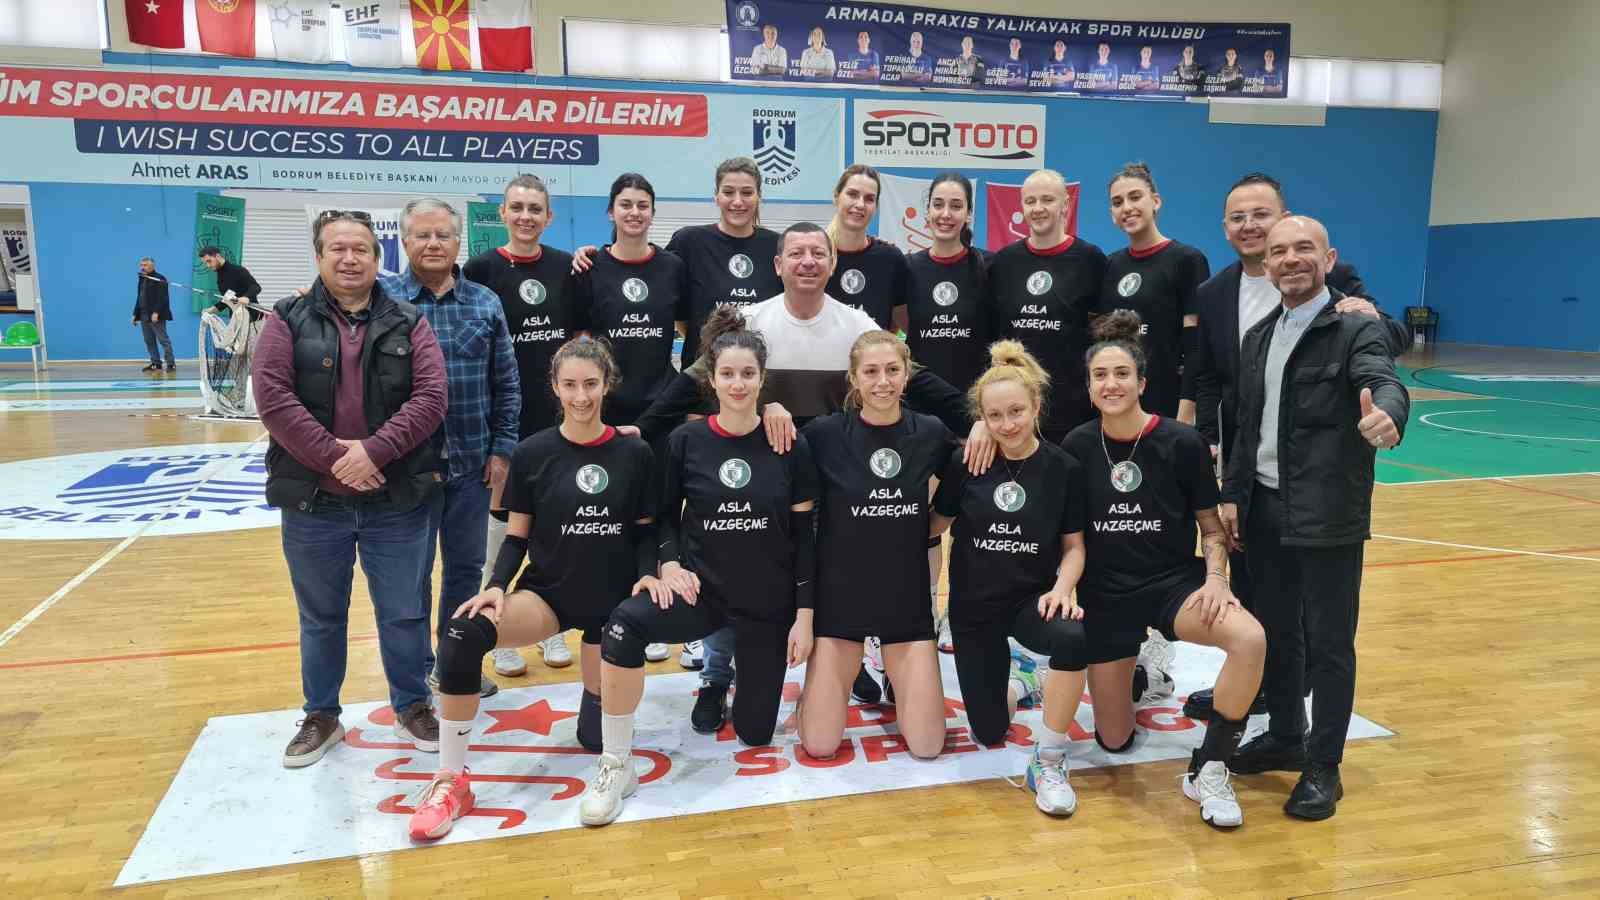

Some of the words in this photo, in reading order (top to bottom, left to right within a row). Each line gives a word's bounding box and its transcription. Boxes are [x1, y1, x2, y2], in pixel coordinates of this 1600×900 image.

[345, 3, 381, 22] EHF
[825, 6, 905, 24] ARMADA
[912, 12, 980, 29] PRAXIS
[986, 17, 1082, 34] YALIKAVAK
[1088, 23, 1132, 36] SPOR
[49, 79, 366, 117] SPORCULARIMIZA
[374, 94, 556, 123] BAŞARILAR
[564, 96, 686, 127] DİLERİM
[752, 108, 797, 119] BODRUM
[96, 125, 105, 148] I
[116, 126, 198, 151] WISH
[207, 129, 345, 155] SUCCESS
[356, 133, 393, 155] TO
[401, 135, 454, 158] ALL
[463, 136, 584, 161] PLAYERS
[131, 161, 191, 179] Ahmet
[196, 164, 249, 181] ARAS
[272, 169, 322, 180] BODRUM
[327, 171, 385, 182] BELEDİYE
[388, 172, 438, 184] BAŞKANI
[452, 175, 490, 185] MAYOR
[494, 176, 510, 185] OF
[730, 287, 757, 297] ASLA
[1020, 304, 1047, 315] ASLA
[522, 315, 551, 328] ASLA
[621, 313, 650, 324] ASLA
[931, 314, 959, 325] ASLA
[1011, 319, 1061, 331] VAZGEÇME
[608, 327, 663, 339] VAZGEÇME
[919, 327, 972, 339] VAZGEÇME
[868, 488, 903, 501] ASLA
[575, 505, 609, 518] ASLA
[717, 501, 752, 514] ASLA
[851, 503, 919, 517] VAZGEÇME
[1108, 503, 1142, 515] ASLA
[703, 517, 769, 531] VAZGEÇME
[988, 523, 1022, 535] ASLA
[1093, 520, 1162, 533] VAZGEÇME
[973, 537, 1039, 554] VAZGEÇME
